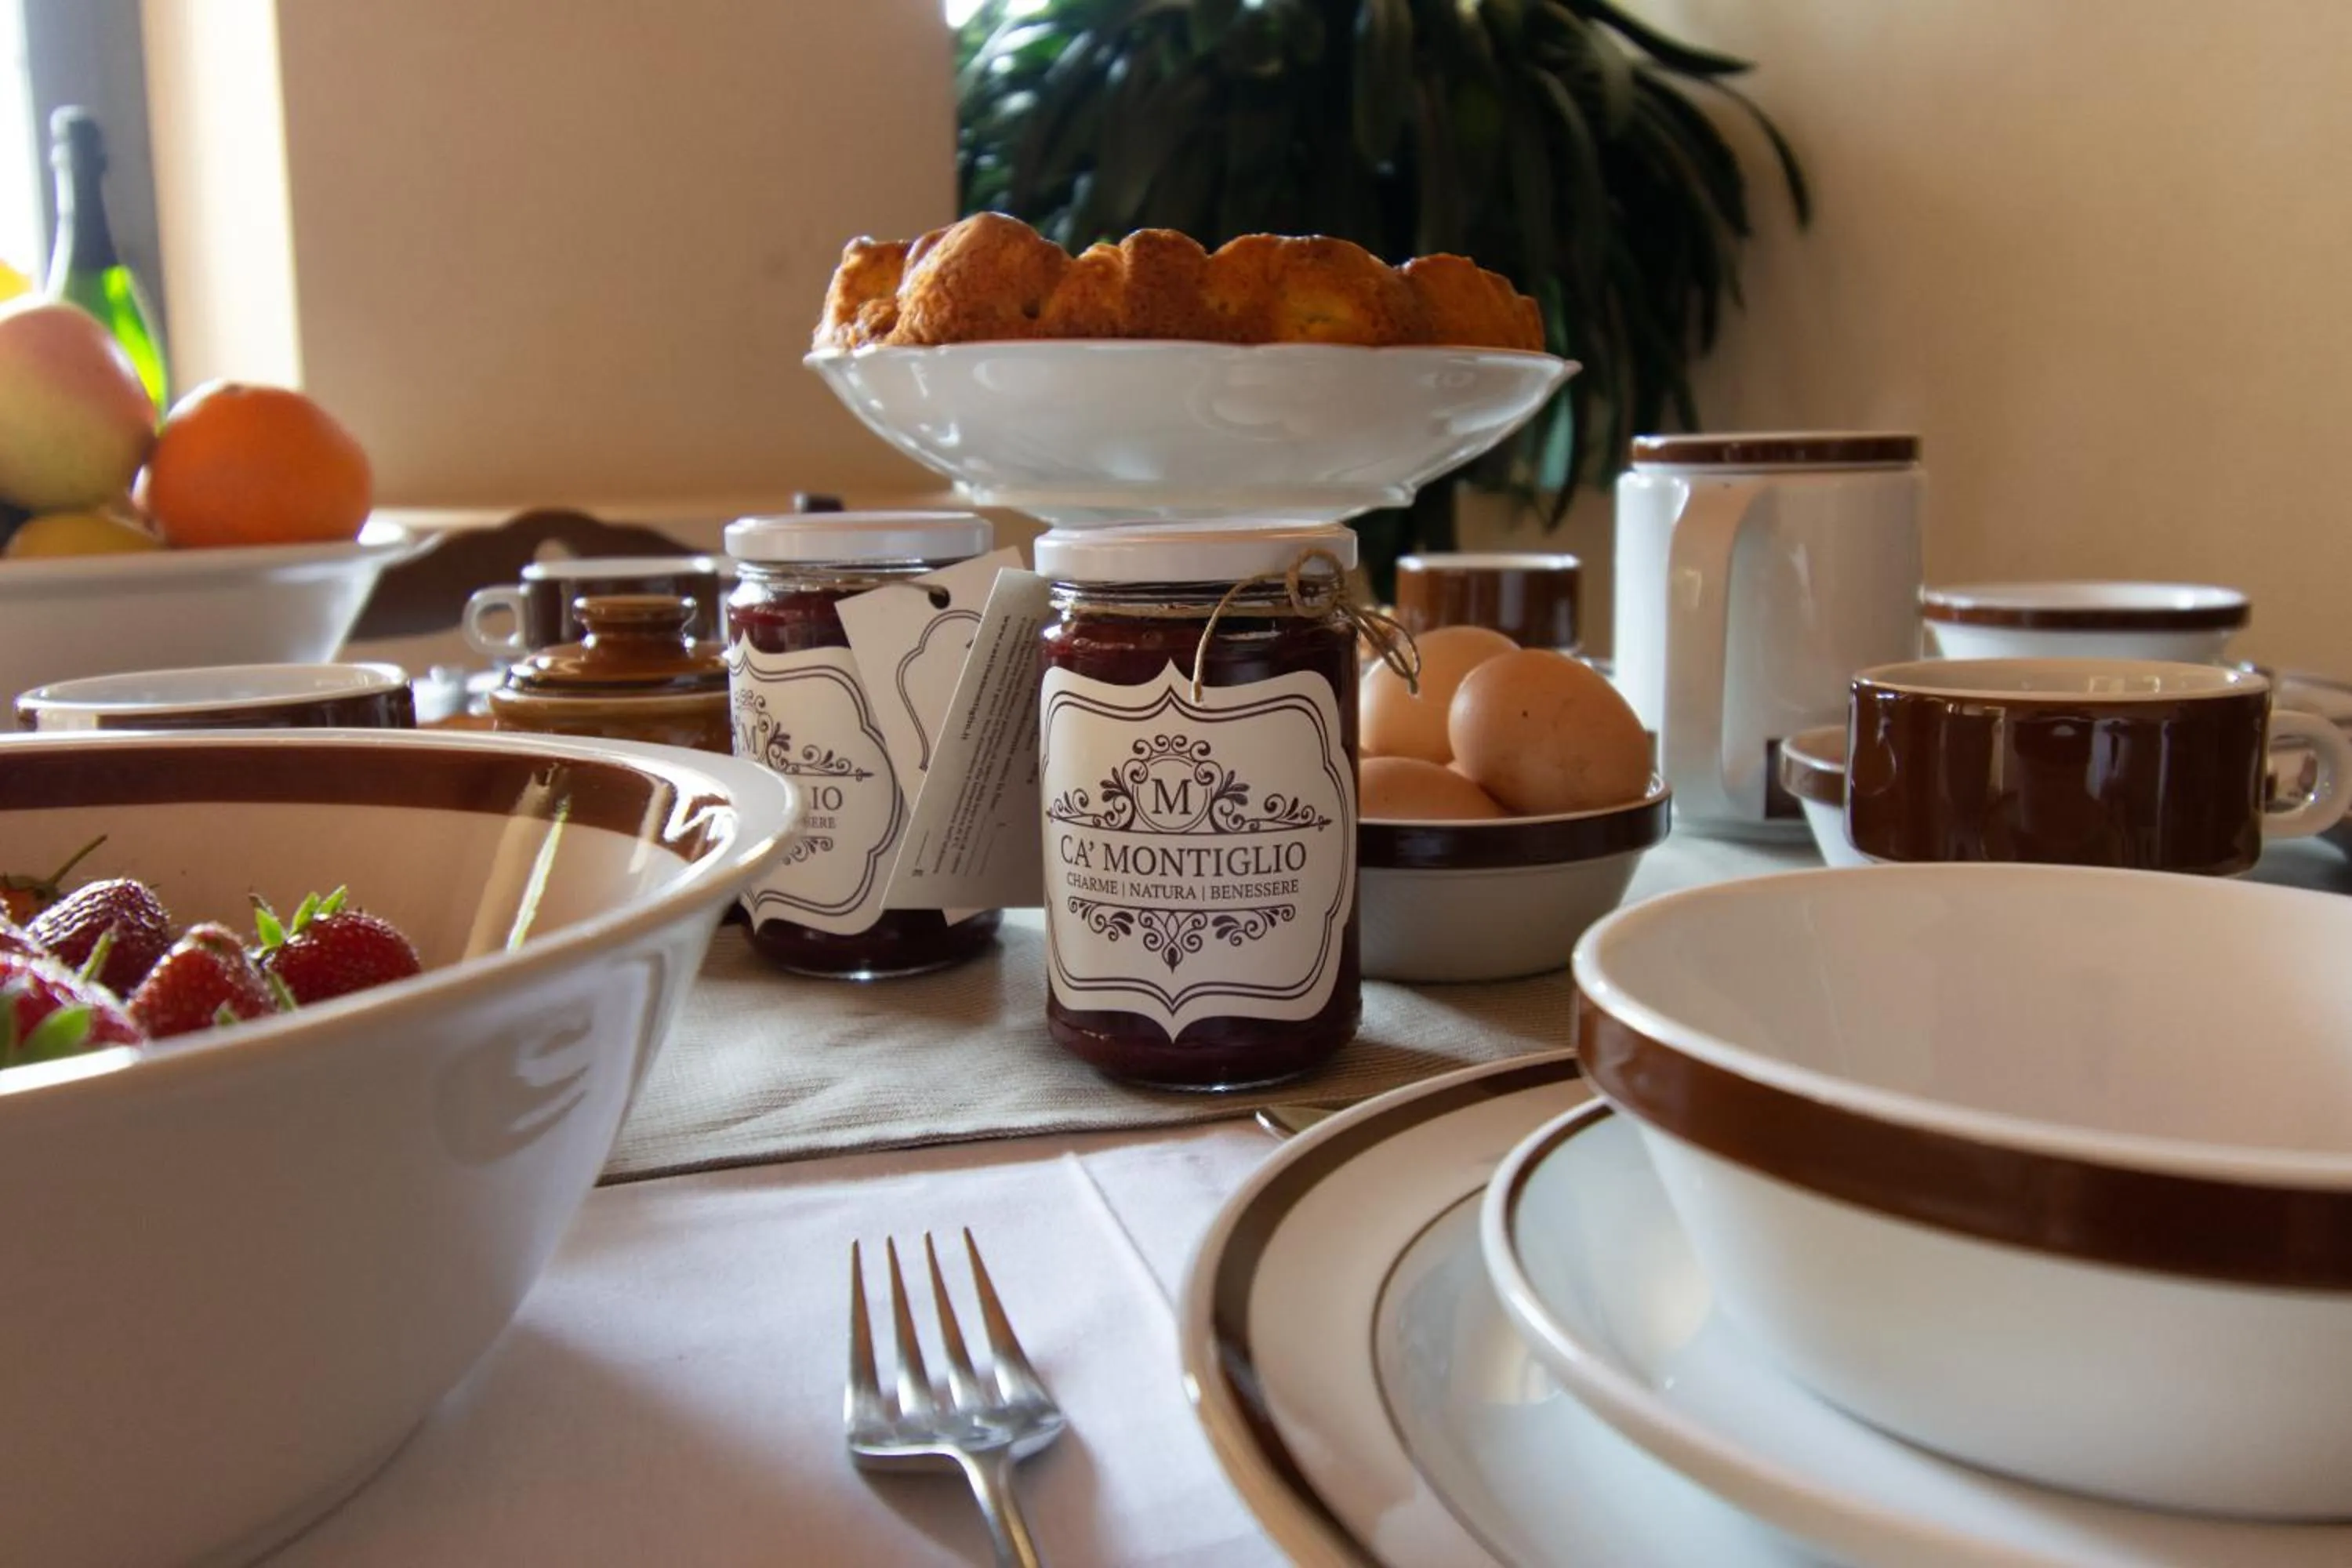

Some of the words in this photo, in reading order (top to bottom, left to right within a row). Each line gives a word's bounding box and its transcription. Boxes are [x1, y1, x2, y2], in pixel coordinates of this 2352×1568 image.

[742, 724, 757, 754] M
[1151, 779, 1192, 815] M
[1103, 841, 1307, 877] MONTIGLIO
[1066, 872, 1118, 895] CHARME
[1130, 884, 1196, 900] NATURA
[1210, 879, 1299, 900] BENESSERE
